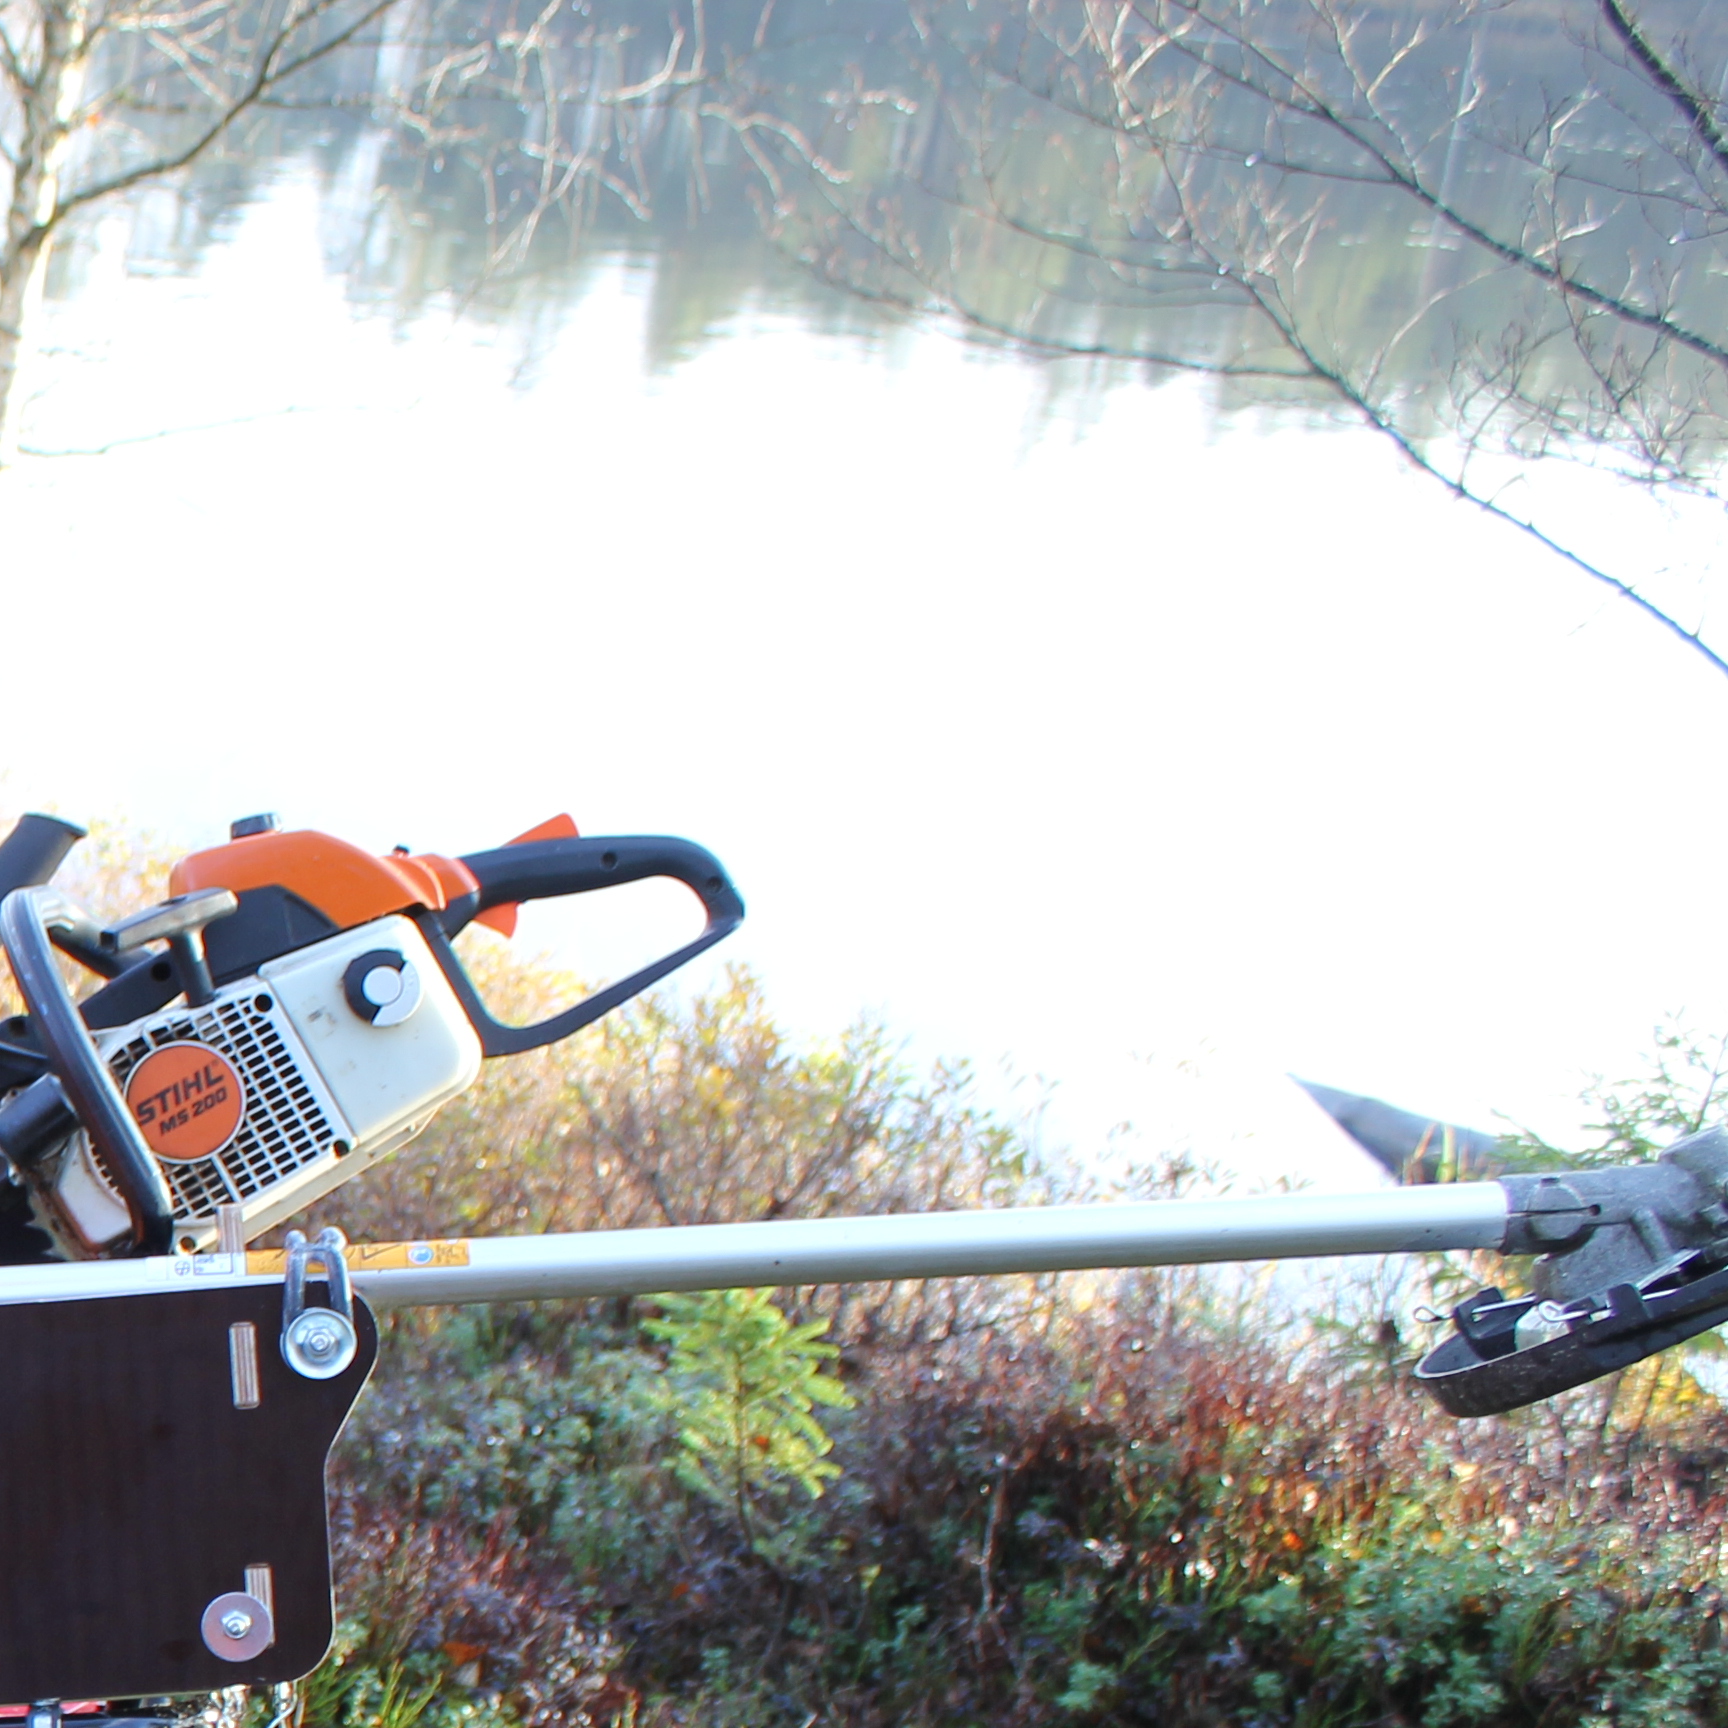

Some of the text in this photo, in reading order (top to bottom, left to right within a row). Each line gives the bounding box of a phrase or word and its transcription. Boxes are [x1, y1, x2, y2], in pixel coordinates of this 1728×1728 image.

[136, 1064, 224, 1126] STIHL
[159, 1086, 228, 1137] MS 200
